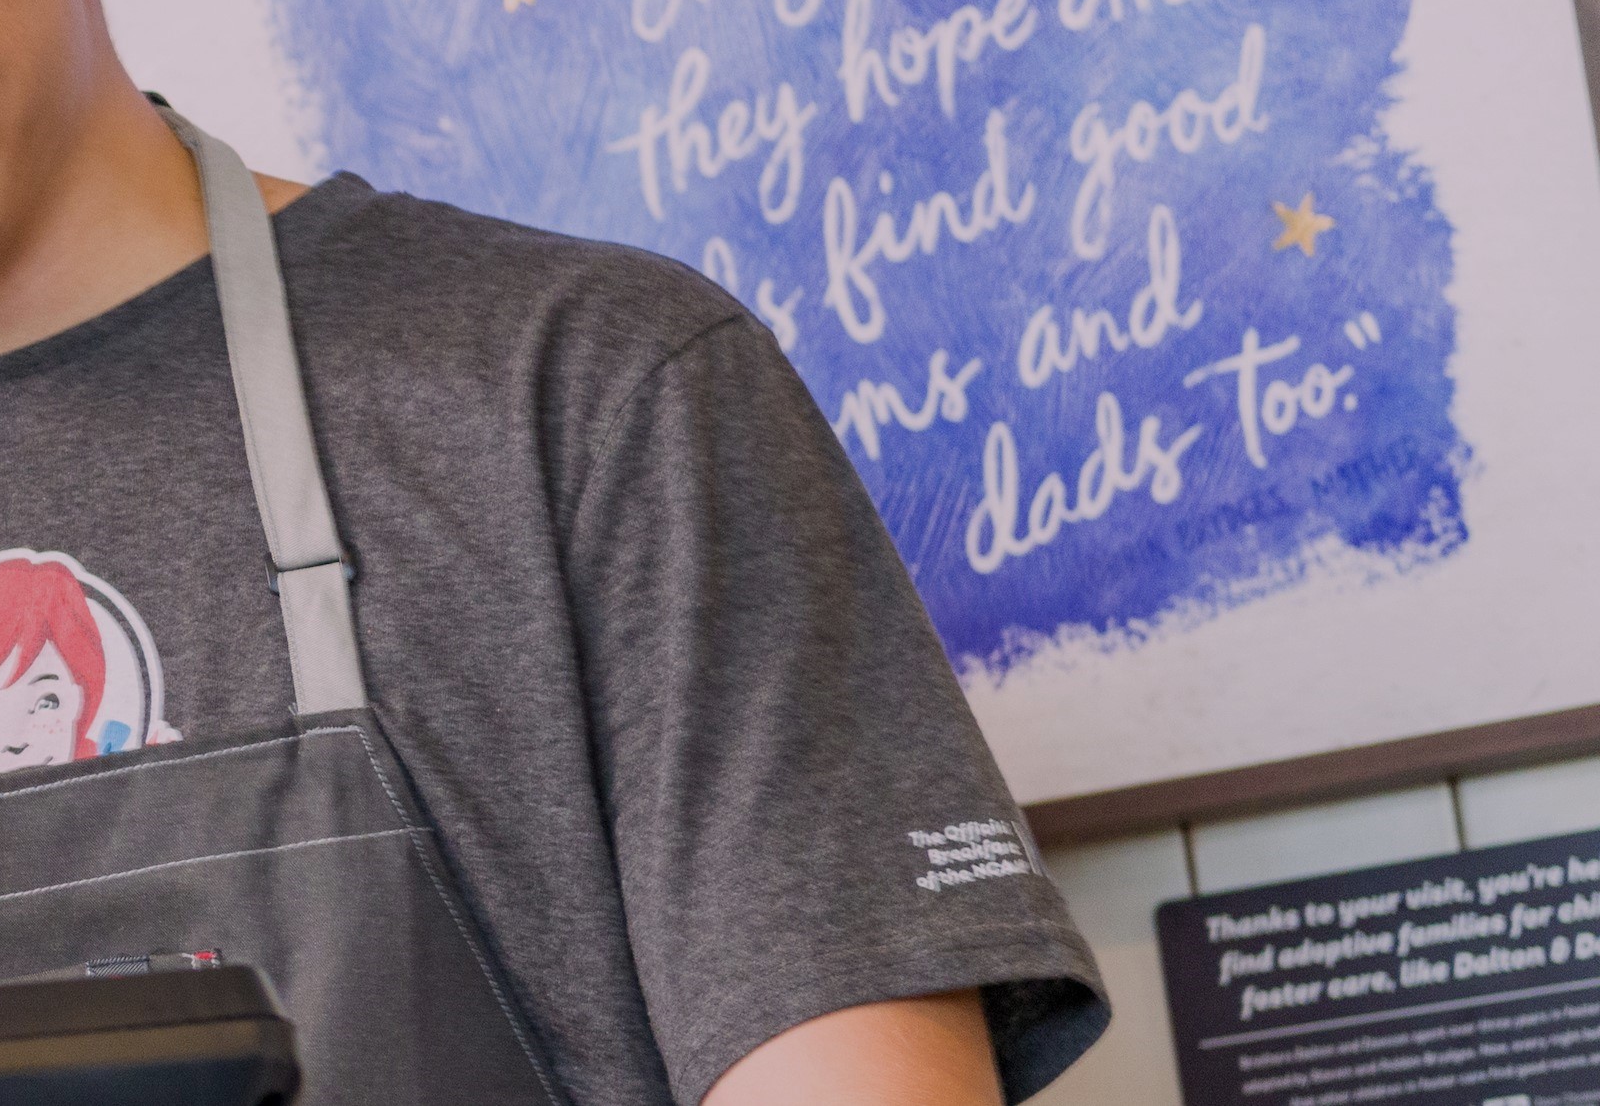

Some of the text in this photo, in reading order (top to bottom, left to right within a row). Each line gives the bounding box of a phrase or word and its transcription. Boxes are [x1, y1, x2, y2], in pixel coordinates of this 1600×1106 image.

[606, 47, 818, 223] they
[823, 107, 1037, 345] find
[1069, 23, 1271, 261] good
[1016, 203, 1202, 390] and
[965, 391, 1201, 575] dads
[1205, 904, 1300, 944] Thanks
[1303, 902, 1335, 928] to
[1338, 891, 1400, 929] your
[1218, 942, 1276, 988] find
[1277, 929, 1396, 970] adoptive
[1394, 910, 1508, 959] families
[1508, 901, 1555, 940] for
[1238, 978, 1324, 1022] foster
[1398, 955, 1450, 989] like
[1452, 944, 1547, 982] Dalton
